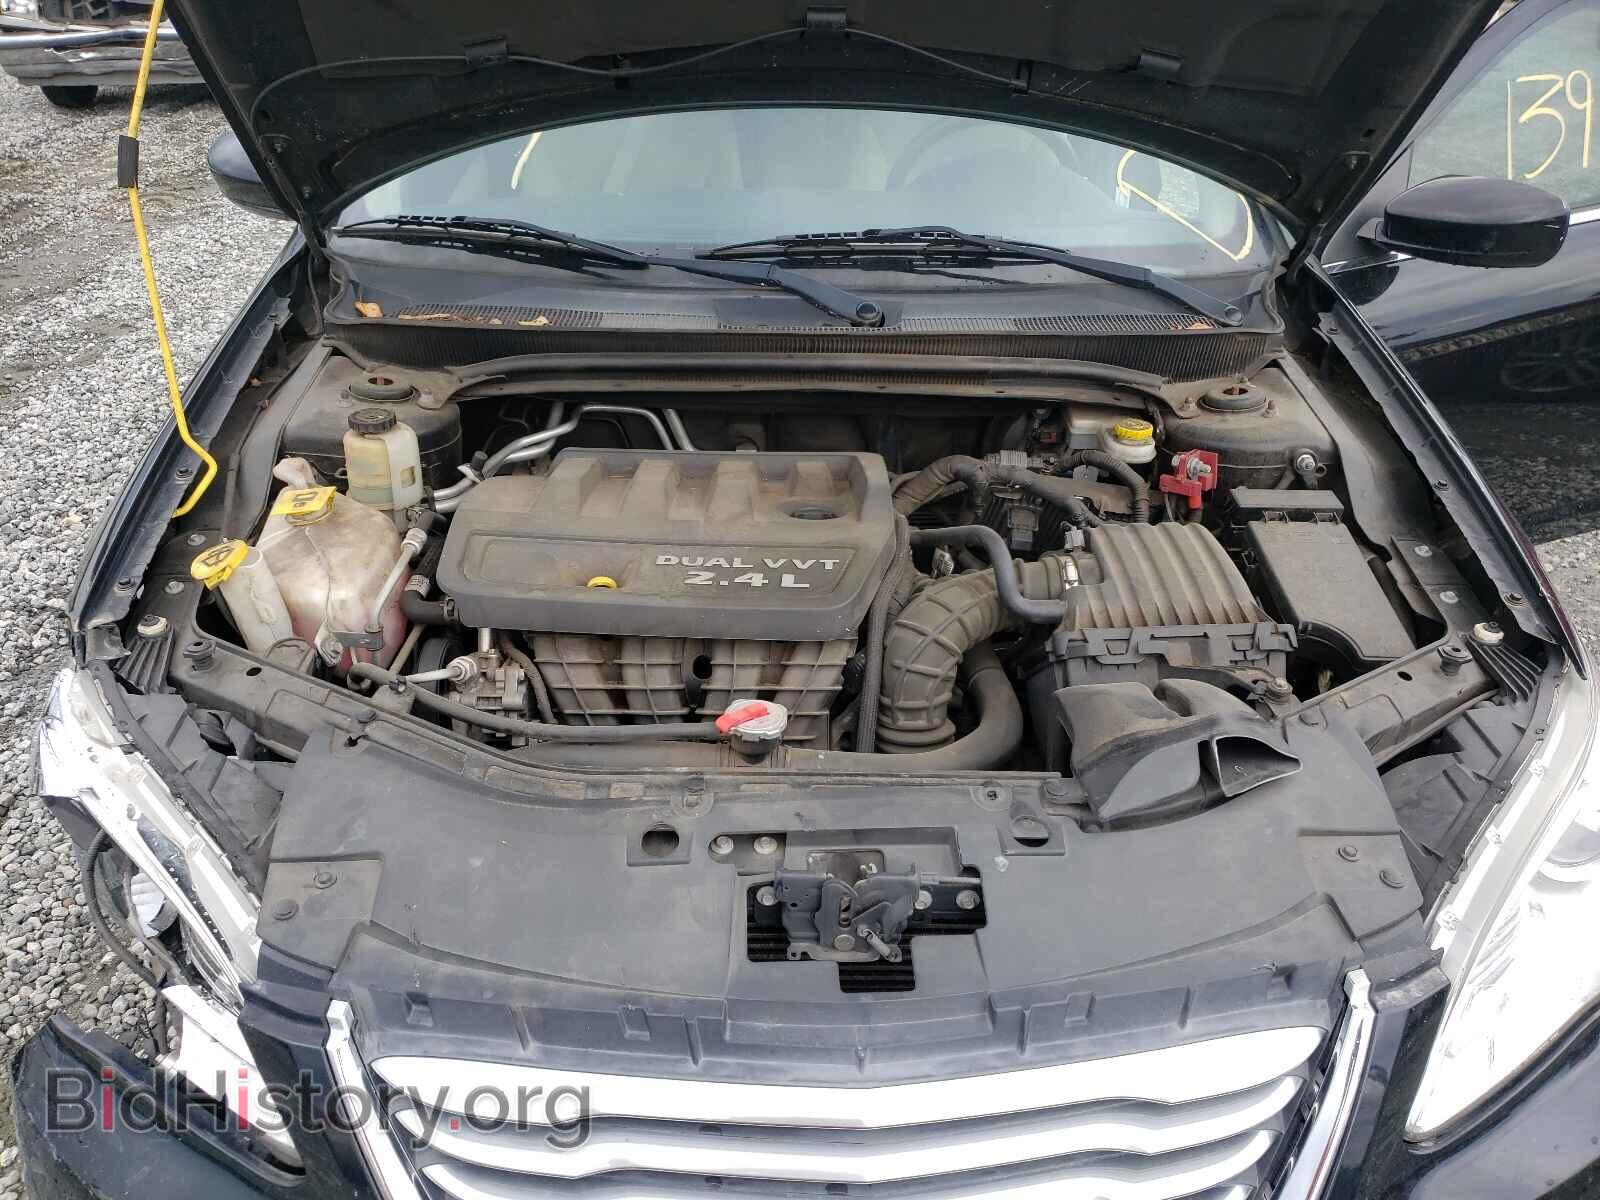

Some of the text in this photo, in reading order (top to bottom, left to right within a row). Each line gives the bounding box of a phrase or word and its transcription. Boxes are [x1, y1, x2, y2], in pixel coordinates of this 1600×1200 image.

[1507, 70, 1592, 180] 139
[655, 555, 840, 570] DUAL VVT
